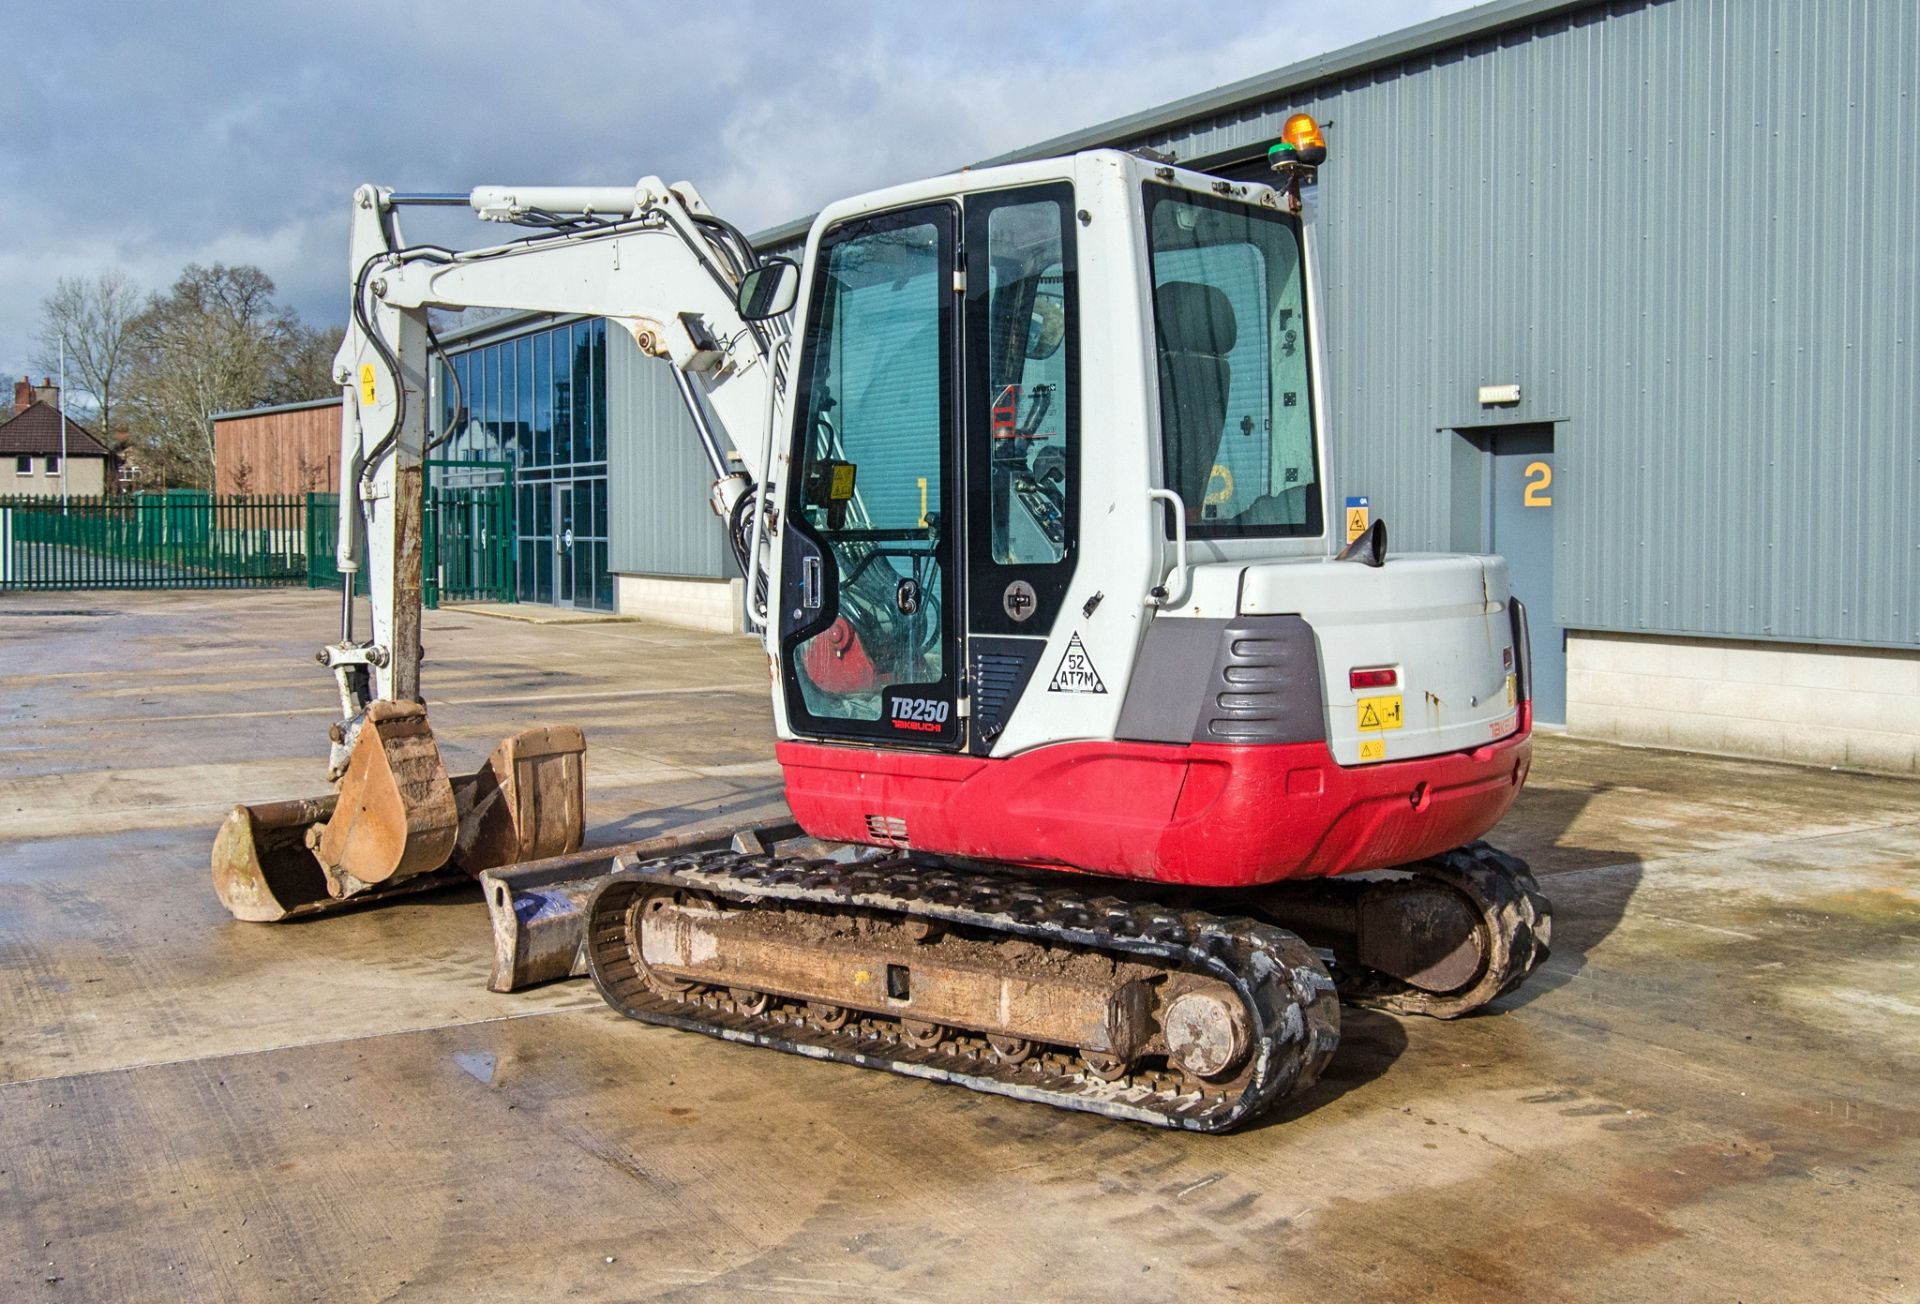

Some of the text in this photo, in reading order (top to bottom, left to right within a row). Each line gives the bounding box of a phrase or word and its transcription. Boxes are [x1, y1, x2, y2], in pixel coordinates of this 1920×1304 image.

[1524, 461, 1553, 507] 2
[917, 477, 929, 528] 1
[1068, 654, 1085, 670] 52
[1061, 671, 1094, 687] AT7M
[891, 696, 950, 723] TB250
[891, 719, 942, 732] TAKEUCHI
